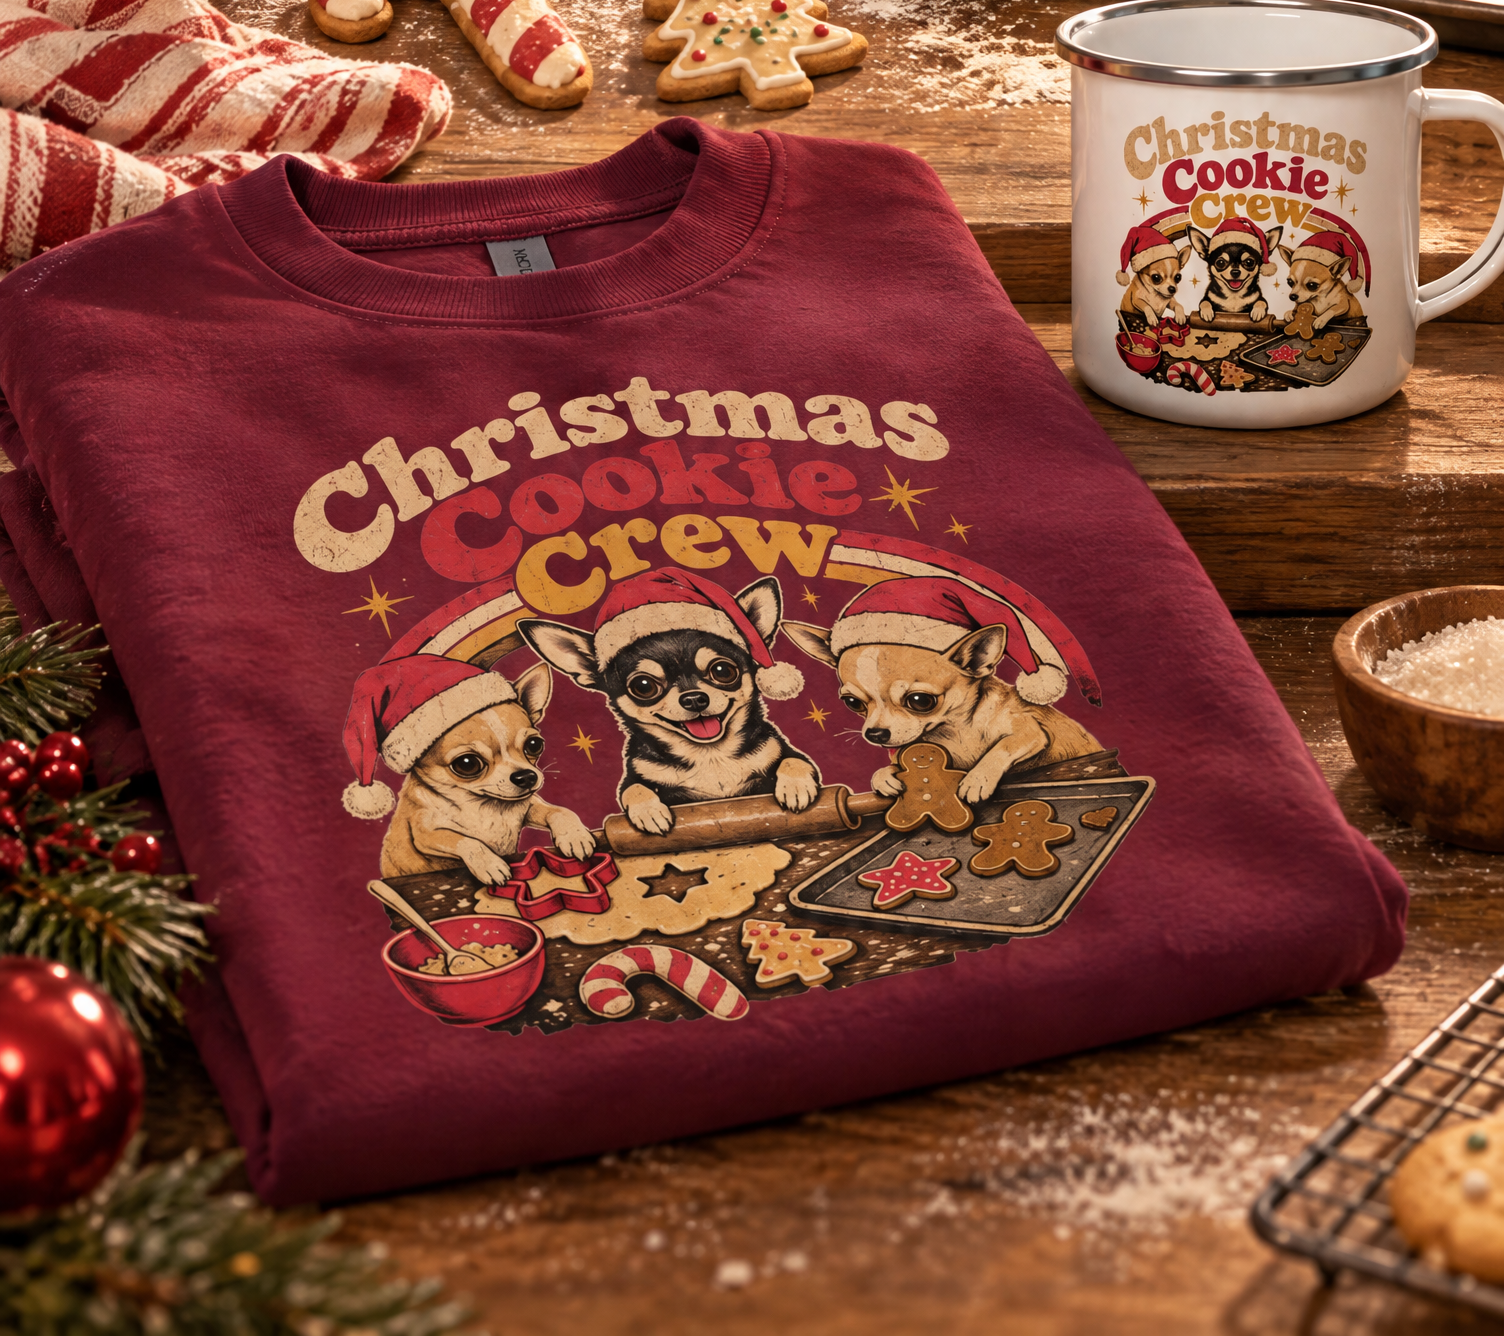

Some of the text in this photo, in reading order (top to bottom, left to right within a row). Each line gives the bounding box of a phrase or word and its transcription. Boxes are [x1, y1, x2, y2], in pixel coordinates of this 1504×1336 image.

[1123, 110, 1367, 180] Christmas
[1162, 151, 1329, 204] Cookie
[293, 376, 950, 573] Christmas
[420, 440, 863, 583] Cookie
